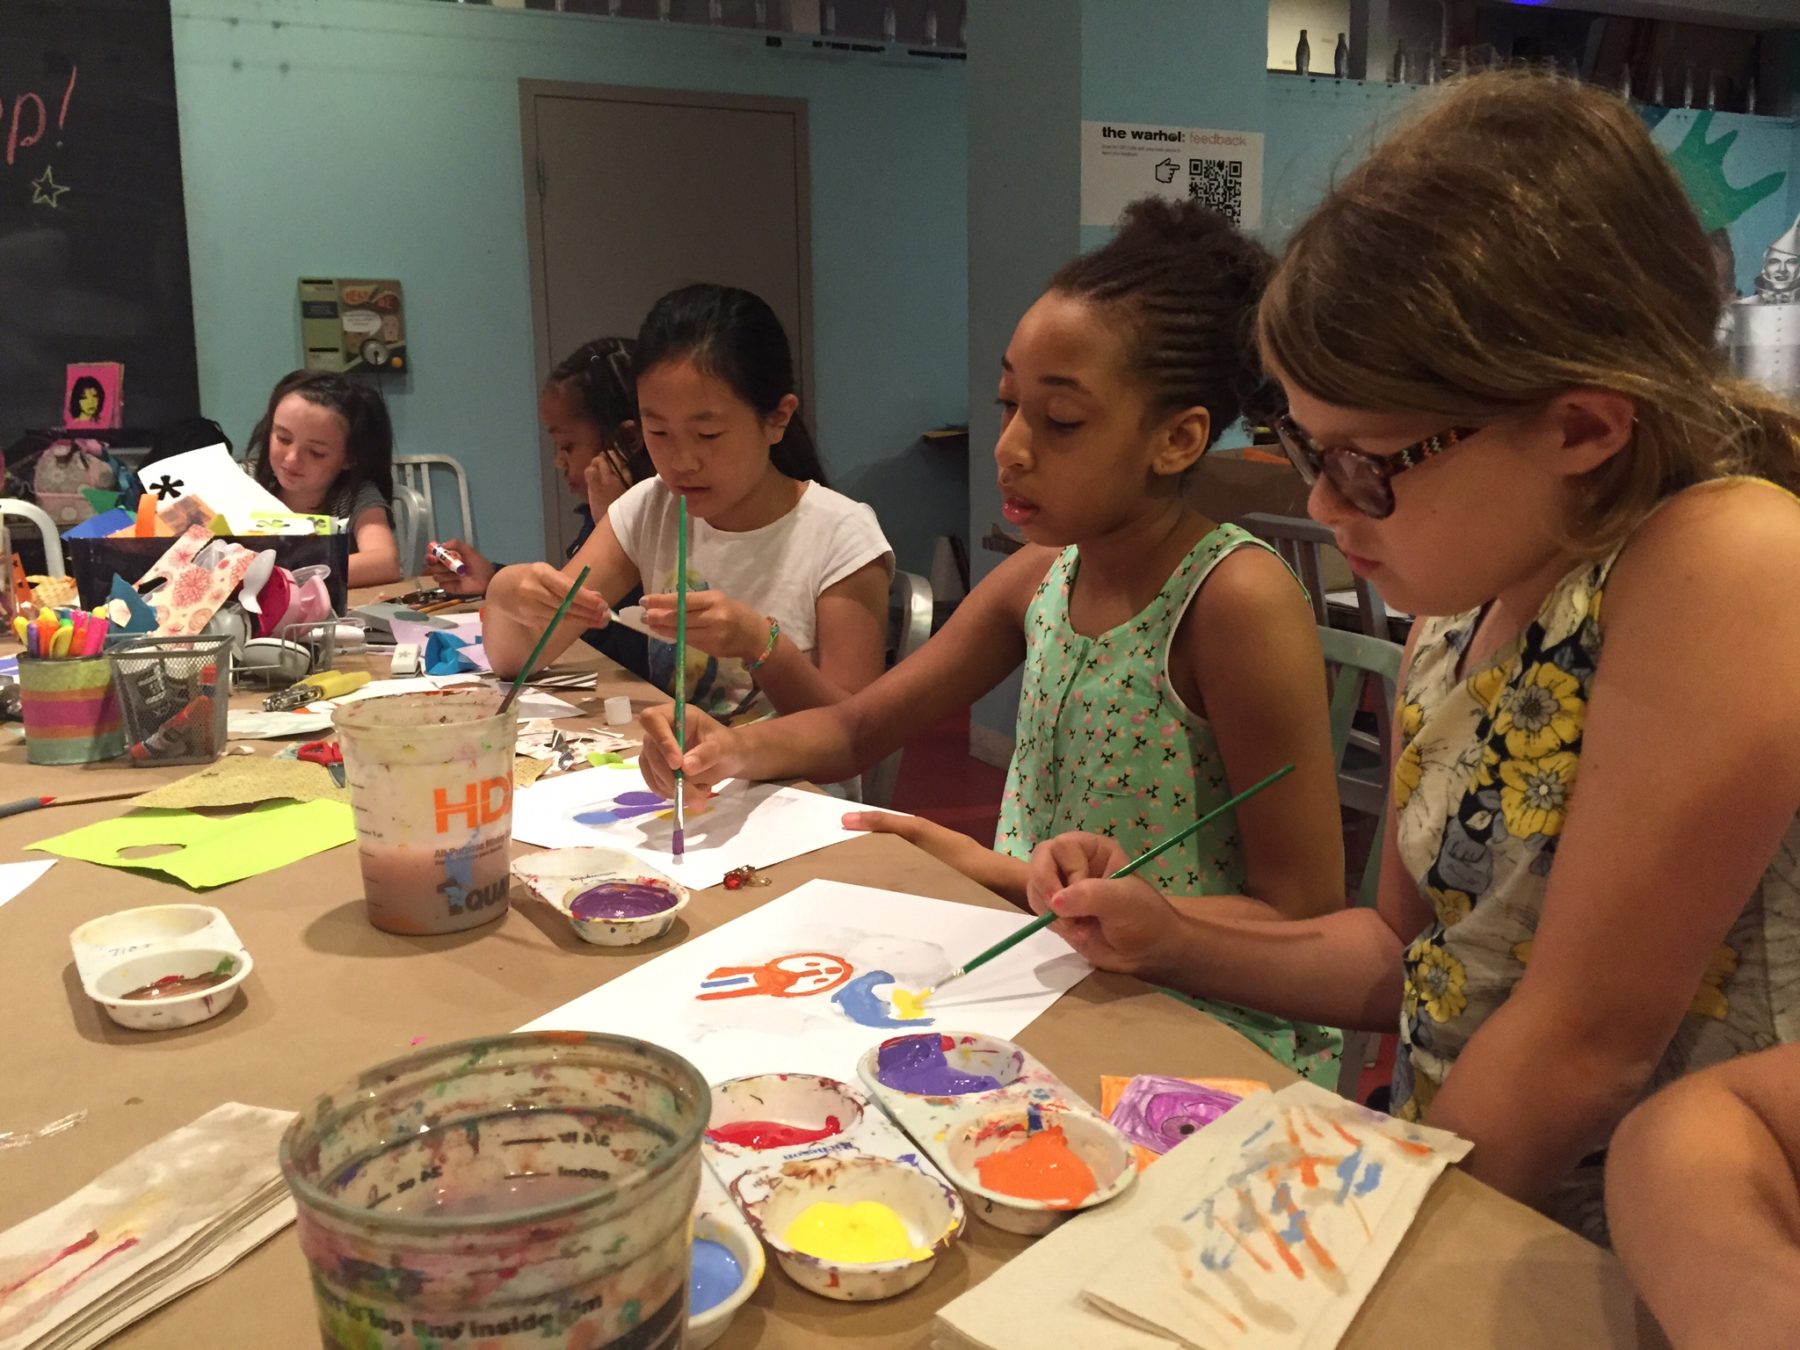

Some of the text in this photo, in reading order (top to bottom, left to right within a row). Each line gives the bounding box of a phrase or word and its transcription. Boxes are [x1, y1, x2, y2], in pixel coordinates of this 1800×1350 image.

[0, 65, 77, 165] p!
[1102, 126, 1248, 147] the warhol: feedback
[433, 769, 513, 834] HD
[465, 874, 511, 912] QUA
